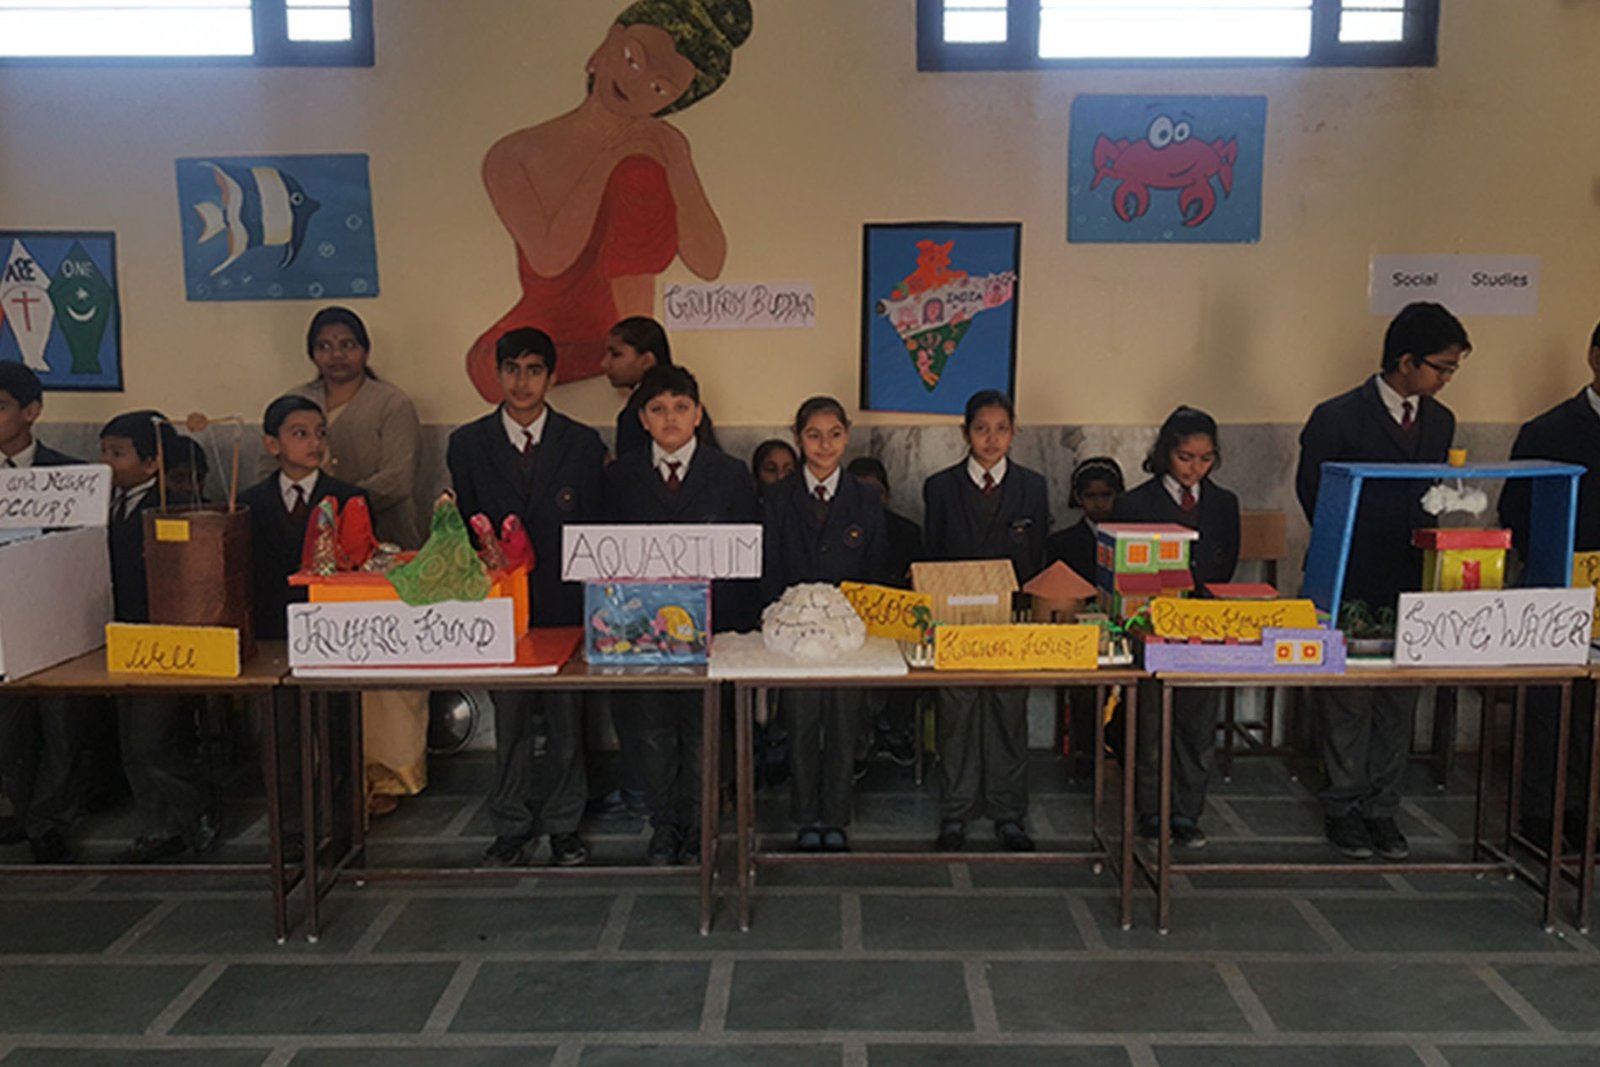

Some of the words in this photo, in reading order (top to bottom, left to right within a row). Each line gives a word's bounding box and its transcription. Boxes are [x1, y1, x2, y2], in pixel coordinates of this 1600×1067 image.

[5, 257, 37, 282] ARE
[62, 259, 94, 279] ONE
[1392, 272, 1439, 287] Social
[1471, 272, 1529, 287] Studies
[946, 290, 983, 304] INDIA
[564, 532, 759, 579] AQUARIUM
[413, 608, 495, 656] KUND
[1402, 599, 1493, 661] SAVE
[1494, 598, 1591, 649] WATER
